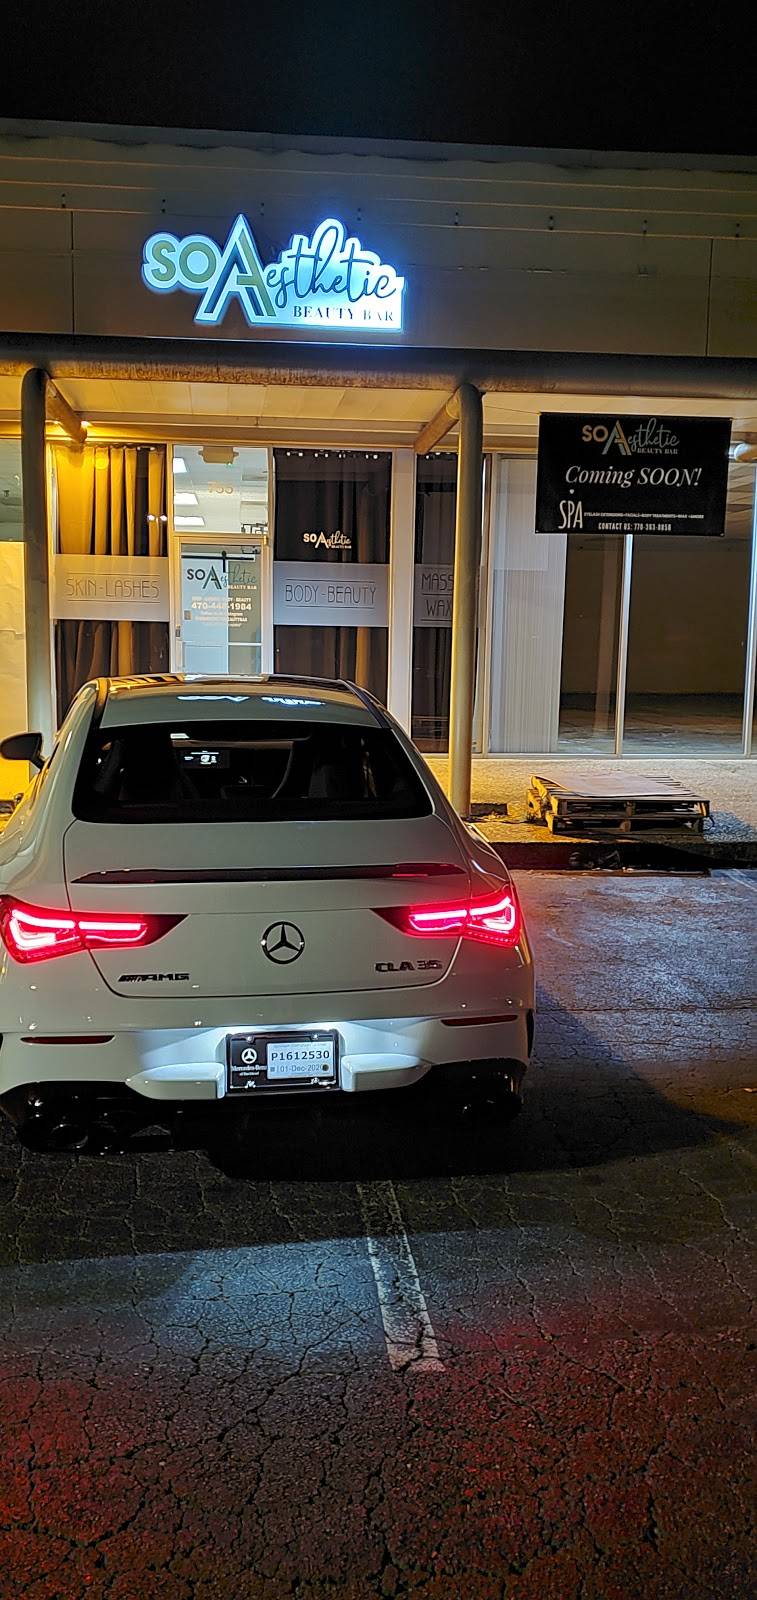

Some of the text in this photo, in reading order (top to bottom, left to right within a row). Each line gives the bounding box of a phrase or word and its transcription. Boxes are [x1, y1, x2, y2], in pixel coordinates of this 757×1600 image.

[293, 305, 394, 322] BEAUTY BAR
[565, 465, 702, 488] Coming SOON!
[558, 500, 583, 529] SPA
[598, 522, 622, 530] CONTACT
[375, 958, 444, 972] CLA 35
[141, 972, 190, 982] AMG
[271, 1050, 330, 1061] P1612530
